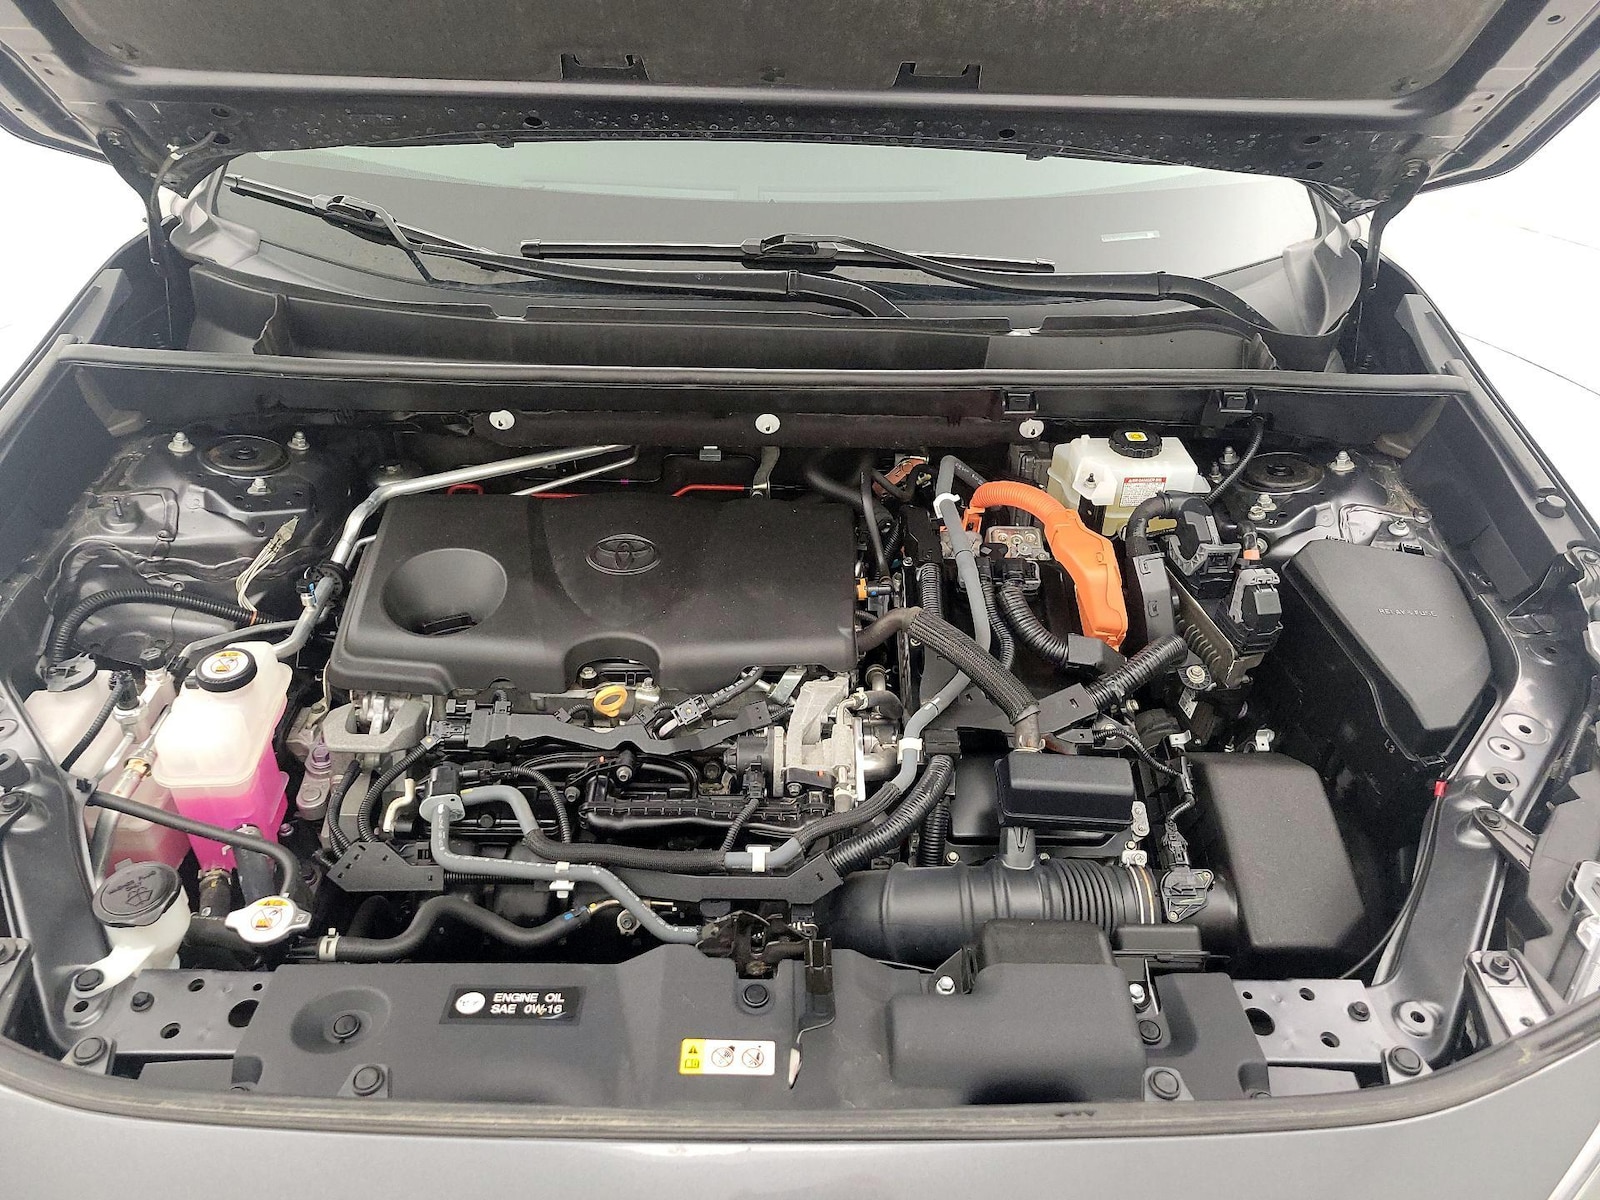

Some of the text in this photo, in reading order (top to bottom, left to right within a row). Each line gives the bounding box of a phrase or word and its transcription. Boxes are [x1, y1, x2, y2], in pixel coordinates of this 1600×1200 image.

[493, 992, 565, 1003] ENGINE OIL
[490, 1003, 563, 1015] SAE 0W-16
